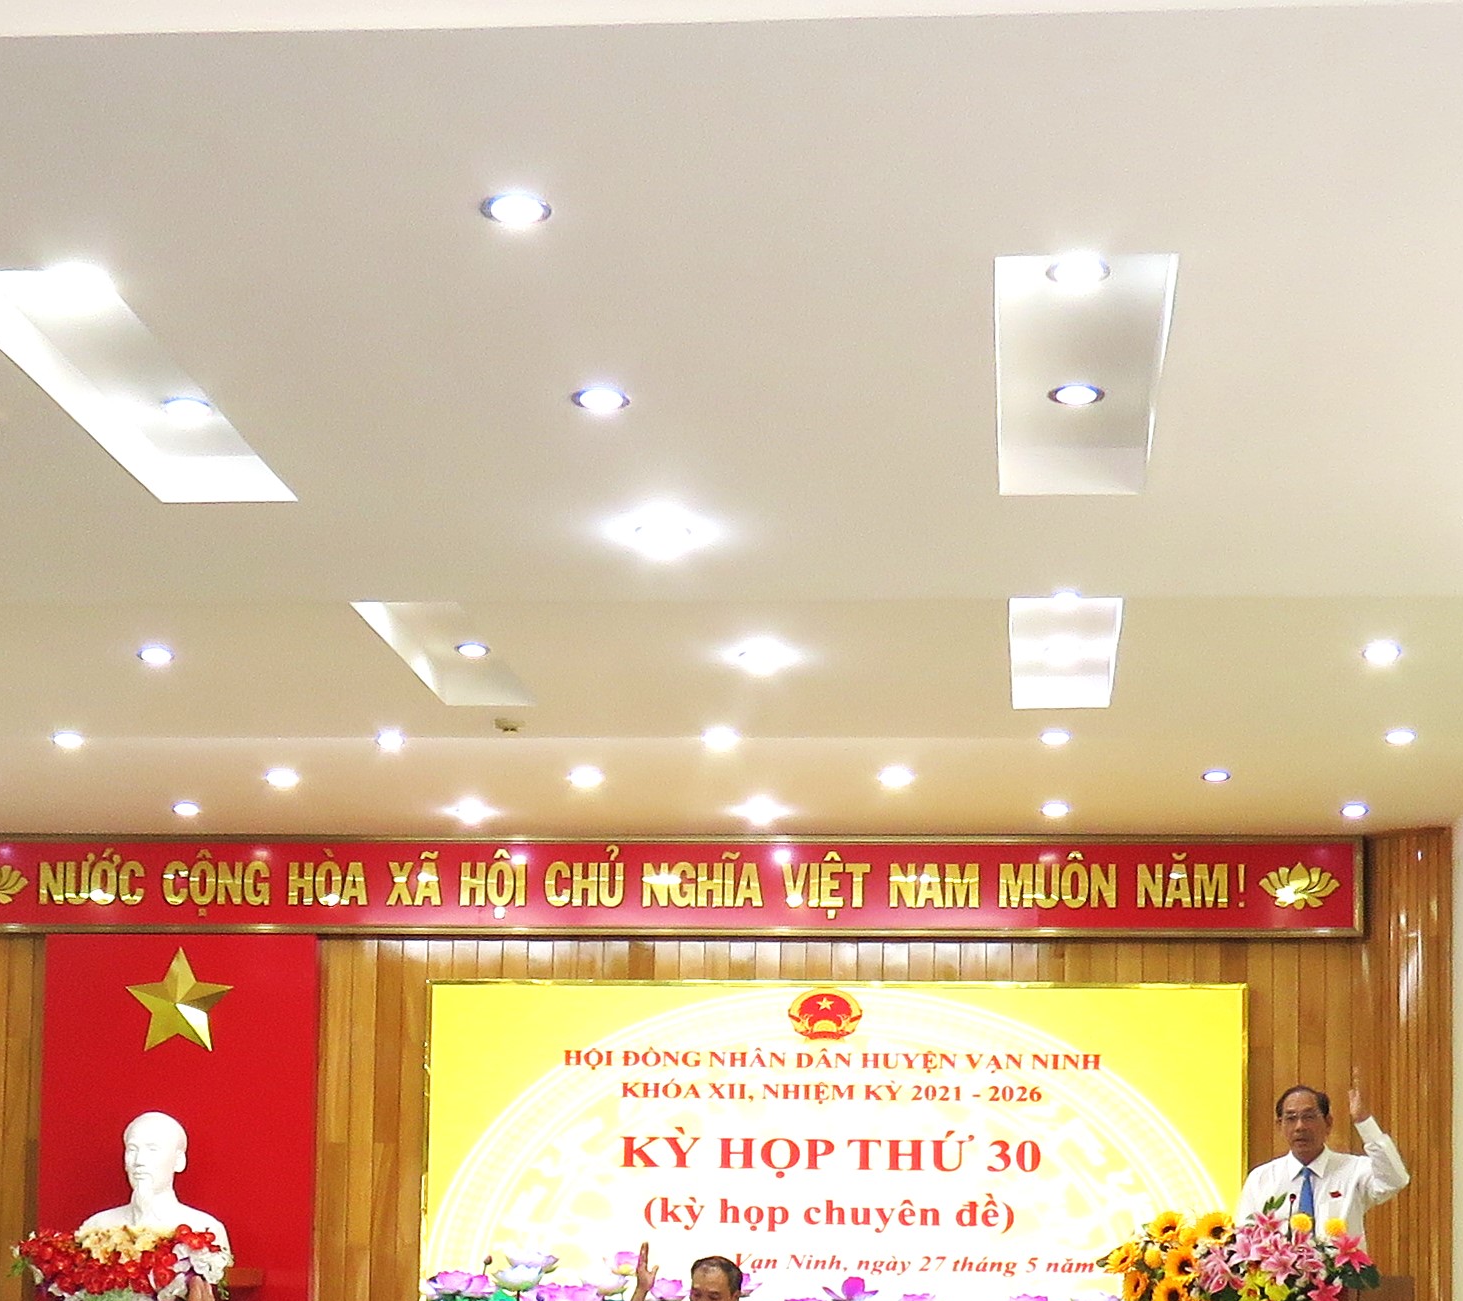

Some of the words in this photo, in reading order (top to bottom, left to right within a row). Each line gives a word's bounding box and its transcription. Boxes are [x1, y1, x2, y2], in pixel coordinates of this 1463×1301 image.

[38, 847, 145, 905] NƯỚC
[162, 848, 272, 917] CỘNG
[287, 848, 369, 906] HÒA
[386, 851, 441, 906] XÃ
[459, 848, 527, 918] HỘI
[544, 845, 625, 906] CHỦ
[642, 851, 764, 907] NGHĨA
[782, 851, 871, 919] VIỆT
[889, 863, 980, 908] NAM
[998, 850, 1117, 908] MUÔN
[564, 1048, 613, 1071] HỘI
[622, 1046, 701, 1068] ĐỒNG
[709, 1047, 786, 1068] NHÂN
[796, 1048, 851, 1069] DÂN
[862, 1050, 957, 1073] HUYỆN
[965, 1053, 1023, 1074] VẠN
[1032, 1053, 1102, 1071] NINH
[622, 1078, 701, 1099] KHÓA
[709, 1083, 755, 1102] XII,
[762, 1082, 856, 1105] NHIỆM
[864, 1080, 903, 1101] KỲ
[911, 1085, 962, 1102] 2021
[989, 1085, 1043, 1102] 2026
[621, 1127, 701, 1168] KỲ
[717, 1138, 835, 1179] HỌP
[847, 1130, 975, 1172] THỨ
[987, 1140, 1042, 1173] 30
[644, 1196, 705, 1231] (kỳ
[719, 1198, 789, 1232] họp
[803, 1199, 941, 1233] chuyên
[955, 1193, 1015, 1234] đề)
[735, 1253, 778, 1273] Vạn
[787, 1254, 848, 1272] Ninh,
[857, 1256, 911, 1276] ngày
[919, 1256, 946, 1272] 27
[952, 1257, 1017, 1277] tháng
[1026, 1257, 1038, 1273] 5
[1046, 1258, 1095, 1273] năm
